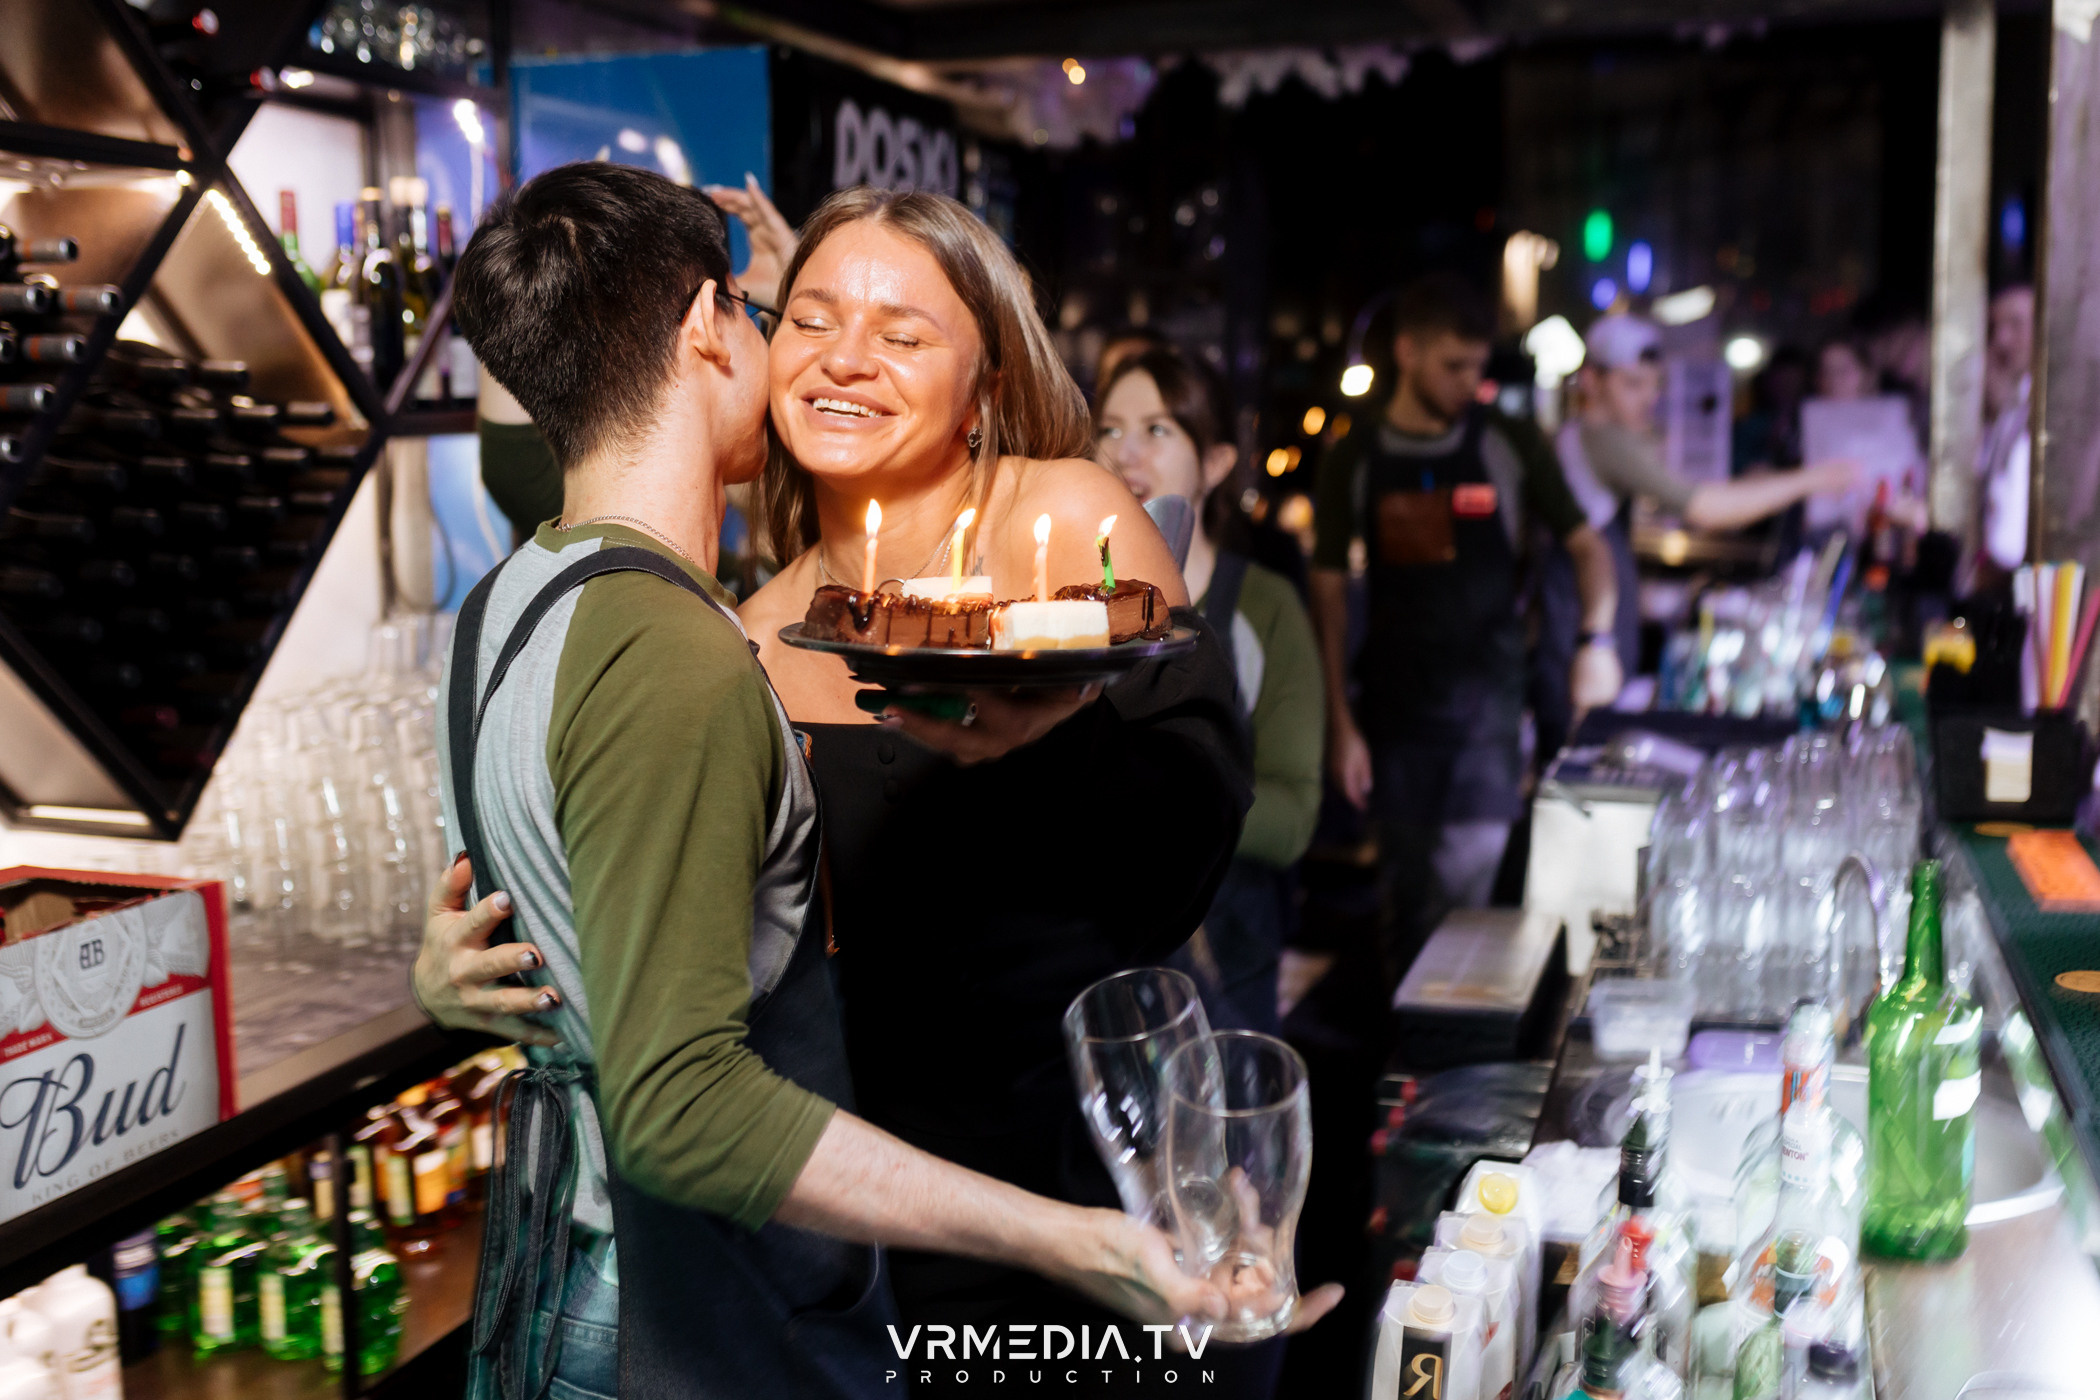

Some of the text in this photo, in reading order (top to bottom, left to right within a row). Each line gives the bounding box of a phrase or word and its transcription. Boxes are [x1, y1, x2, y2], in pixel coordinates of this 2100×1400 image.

[0, 1023, 186, 1189] Bud
[32, 1129, 179, 1204] KING OF BEERS
